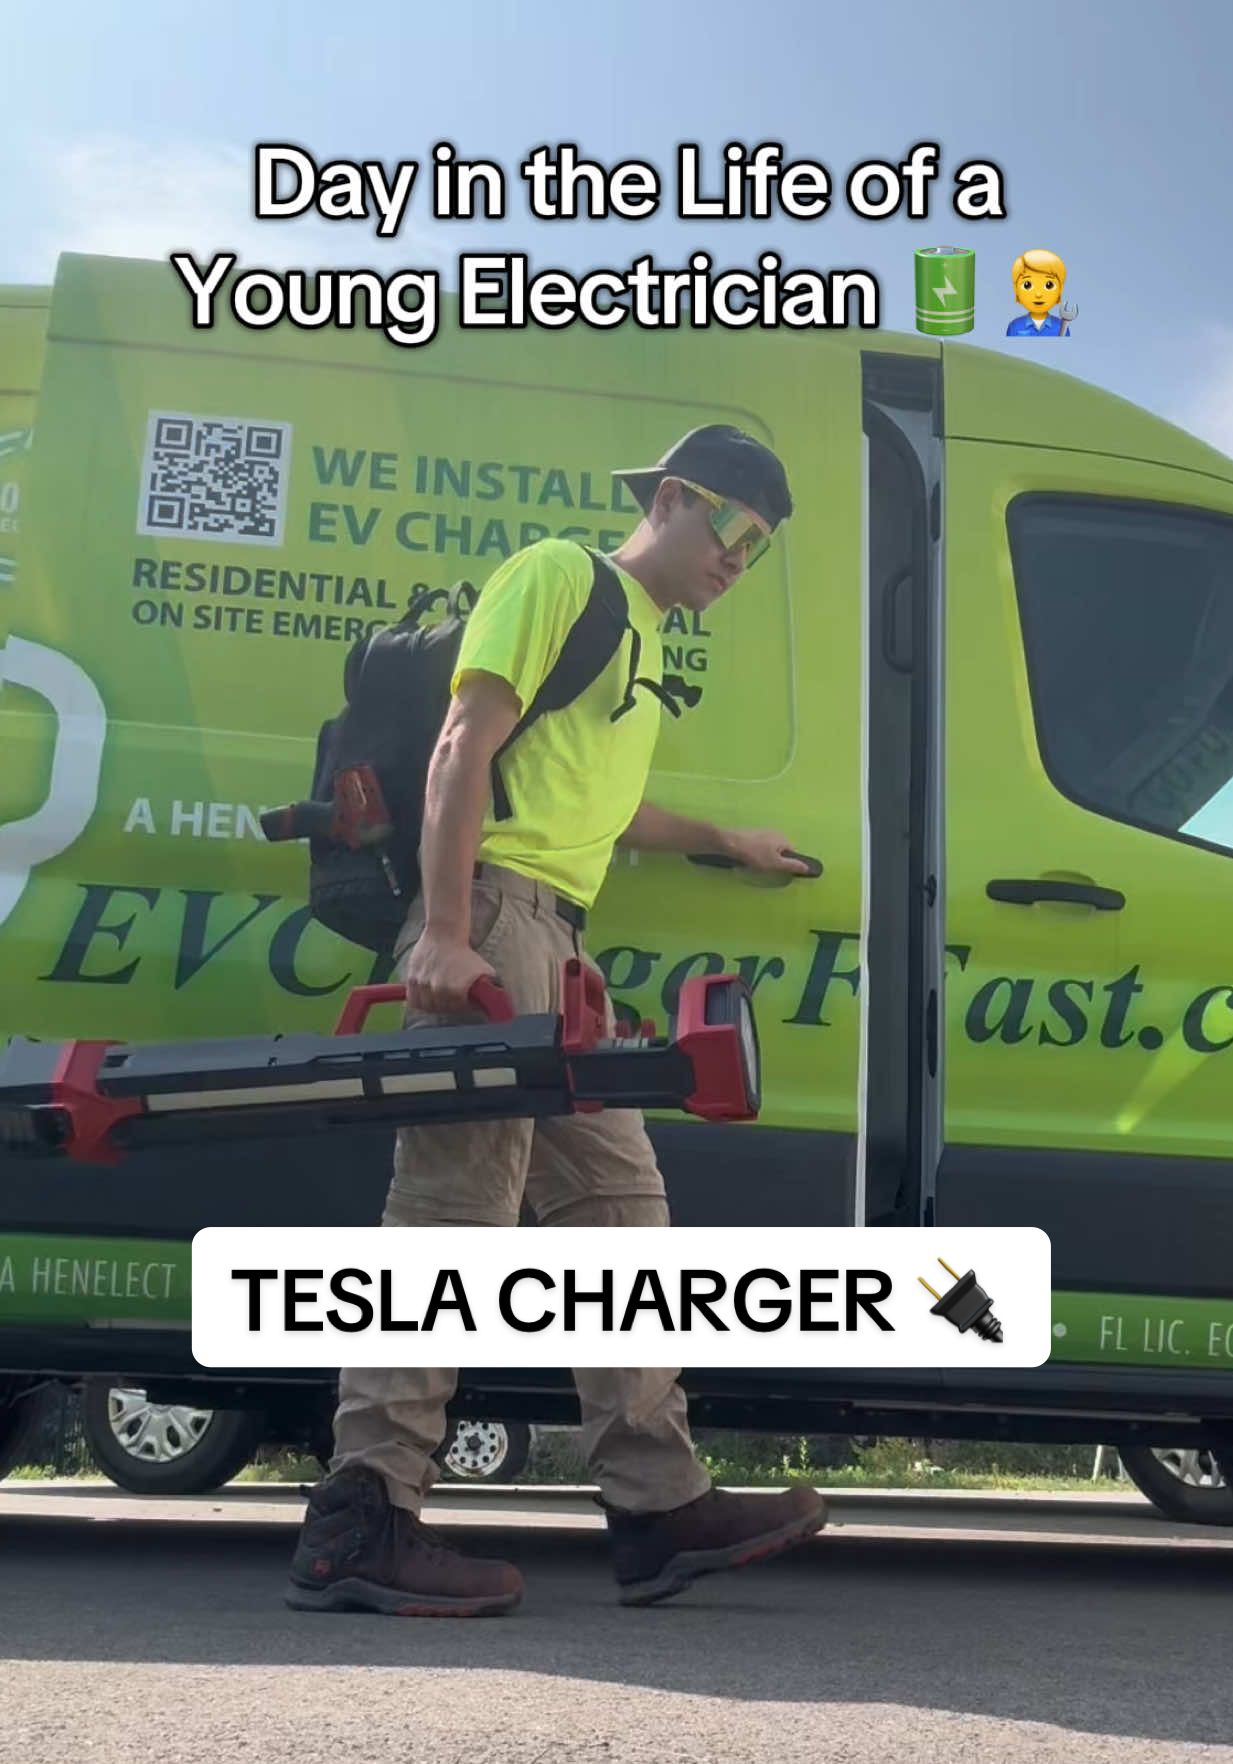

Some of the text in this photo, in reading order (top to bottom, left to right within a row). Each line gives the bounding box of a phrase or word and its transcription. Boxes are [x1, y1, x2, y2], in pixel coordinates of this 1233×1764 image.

[311, 445, 639, 513] WE INSTALL
[308, 501, 381, 546] EV
[132, 557, 397, 609] RESIDENTIAL
[132, 599, 183, 628] ON
[193, 604, 264, 635] SITE
[123, 797, 157, 834] A
[0, 1255, 177, 1299] A HENELECT
[1100, 1315, 1128, 1351] FL
[1143, 1317, 1190, 1355] LIC.
